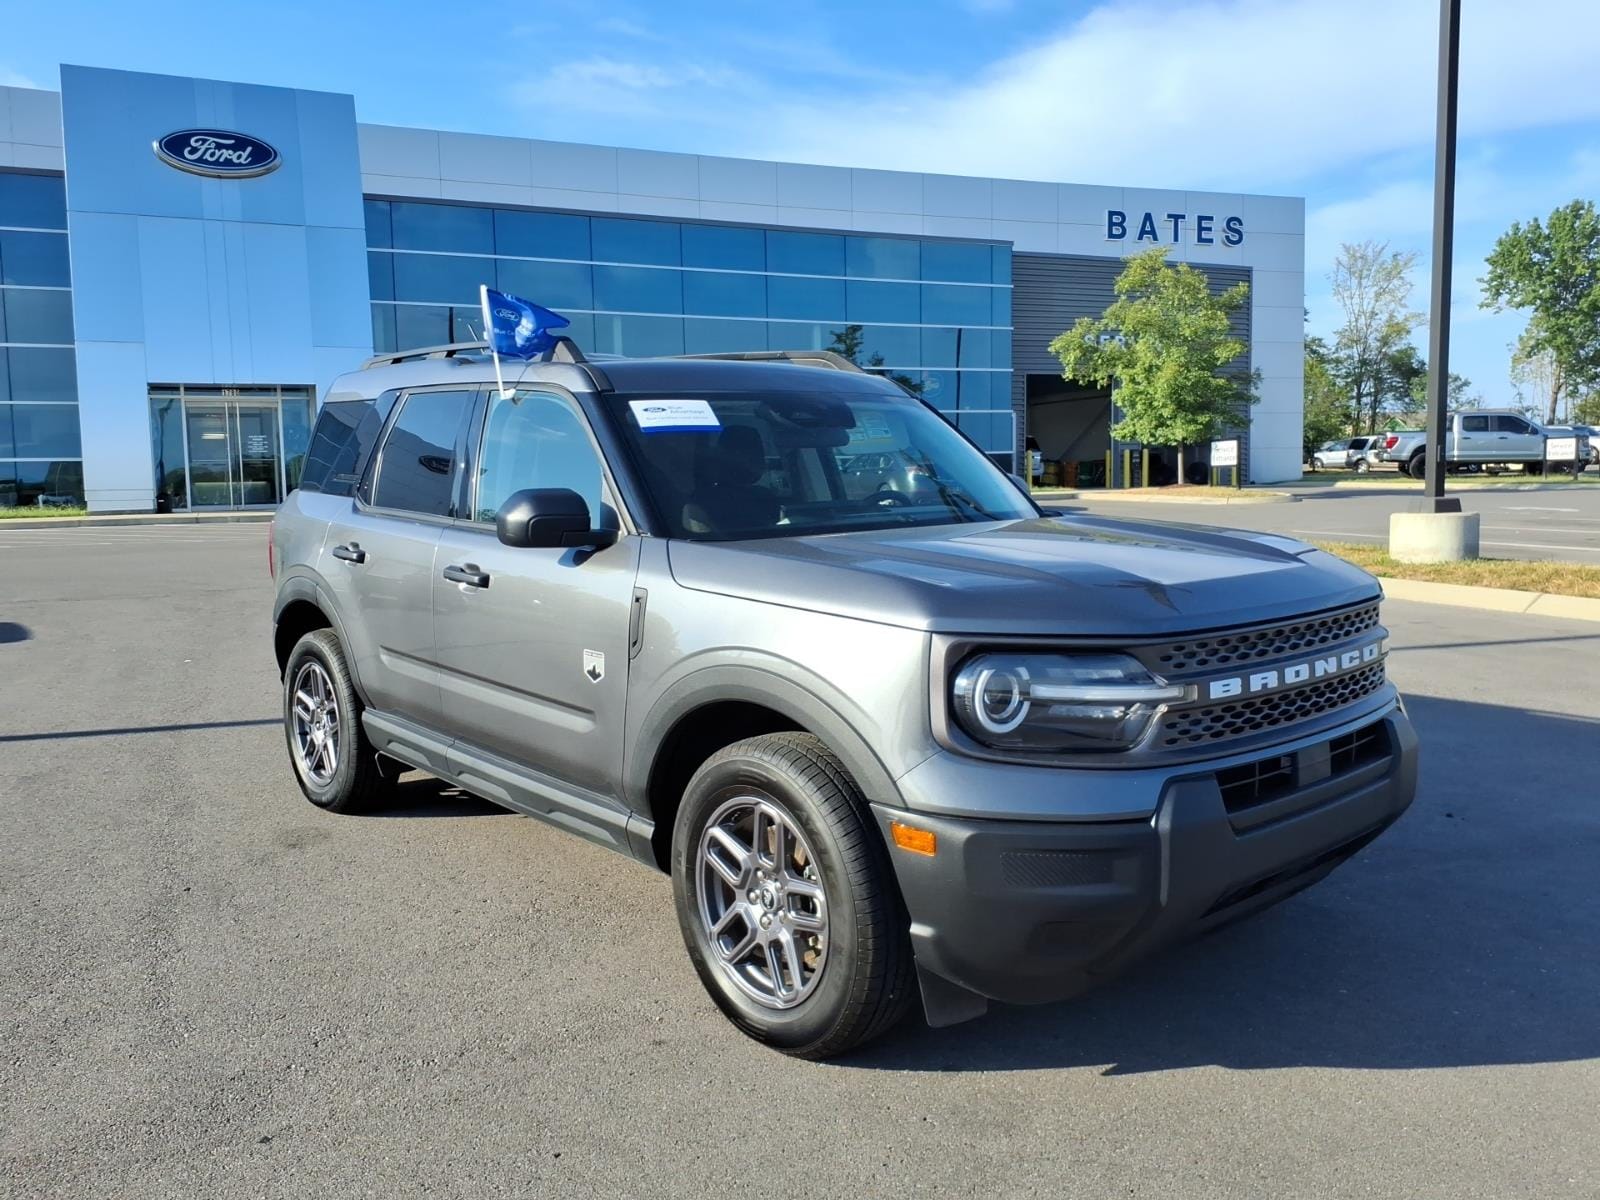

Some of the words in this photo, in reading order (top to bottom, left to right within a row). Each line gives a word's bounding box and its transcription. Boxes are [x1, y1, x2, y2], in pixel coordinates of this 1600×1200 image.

[184, 135, 253, 164] Ford
[1106, 210, 1244, 246] BATES
[1209, 643, 1379, 699] BRONCO
